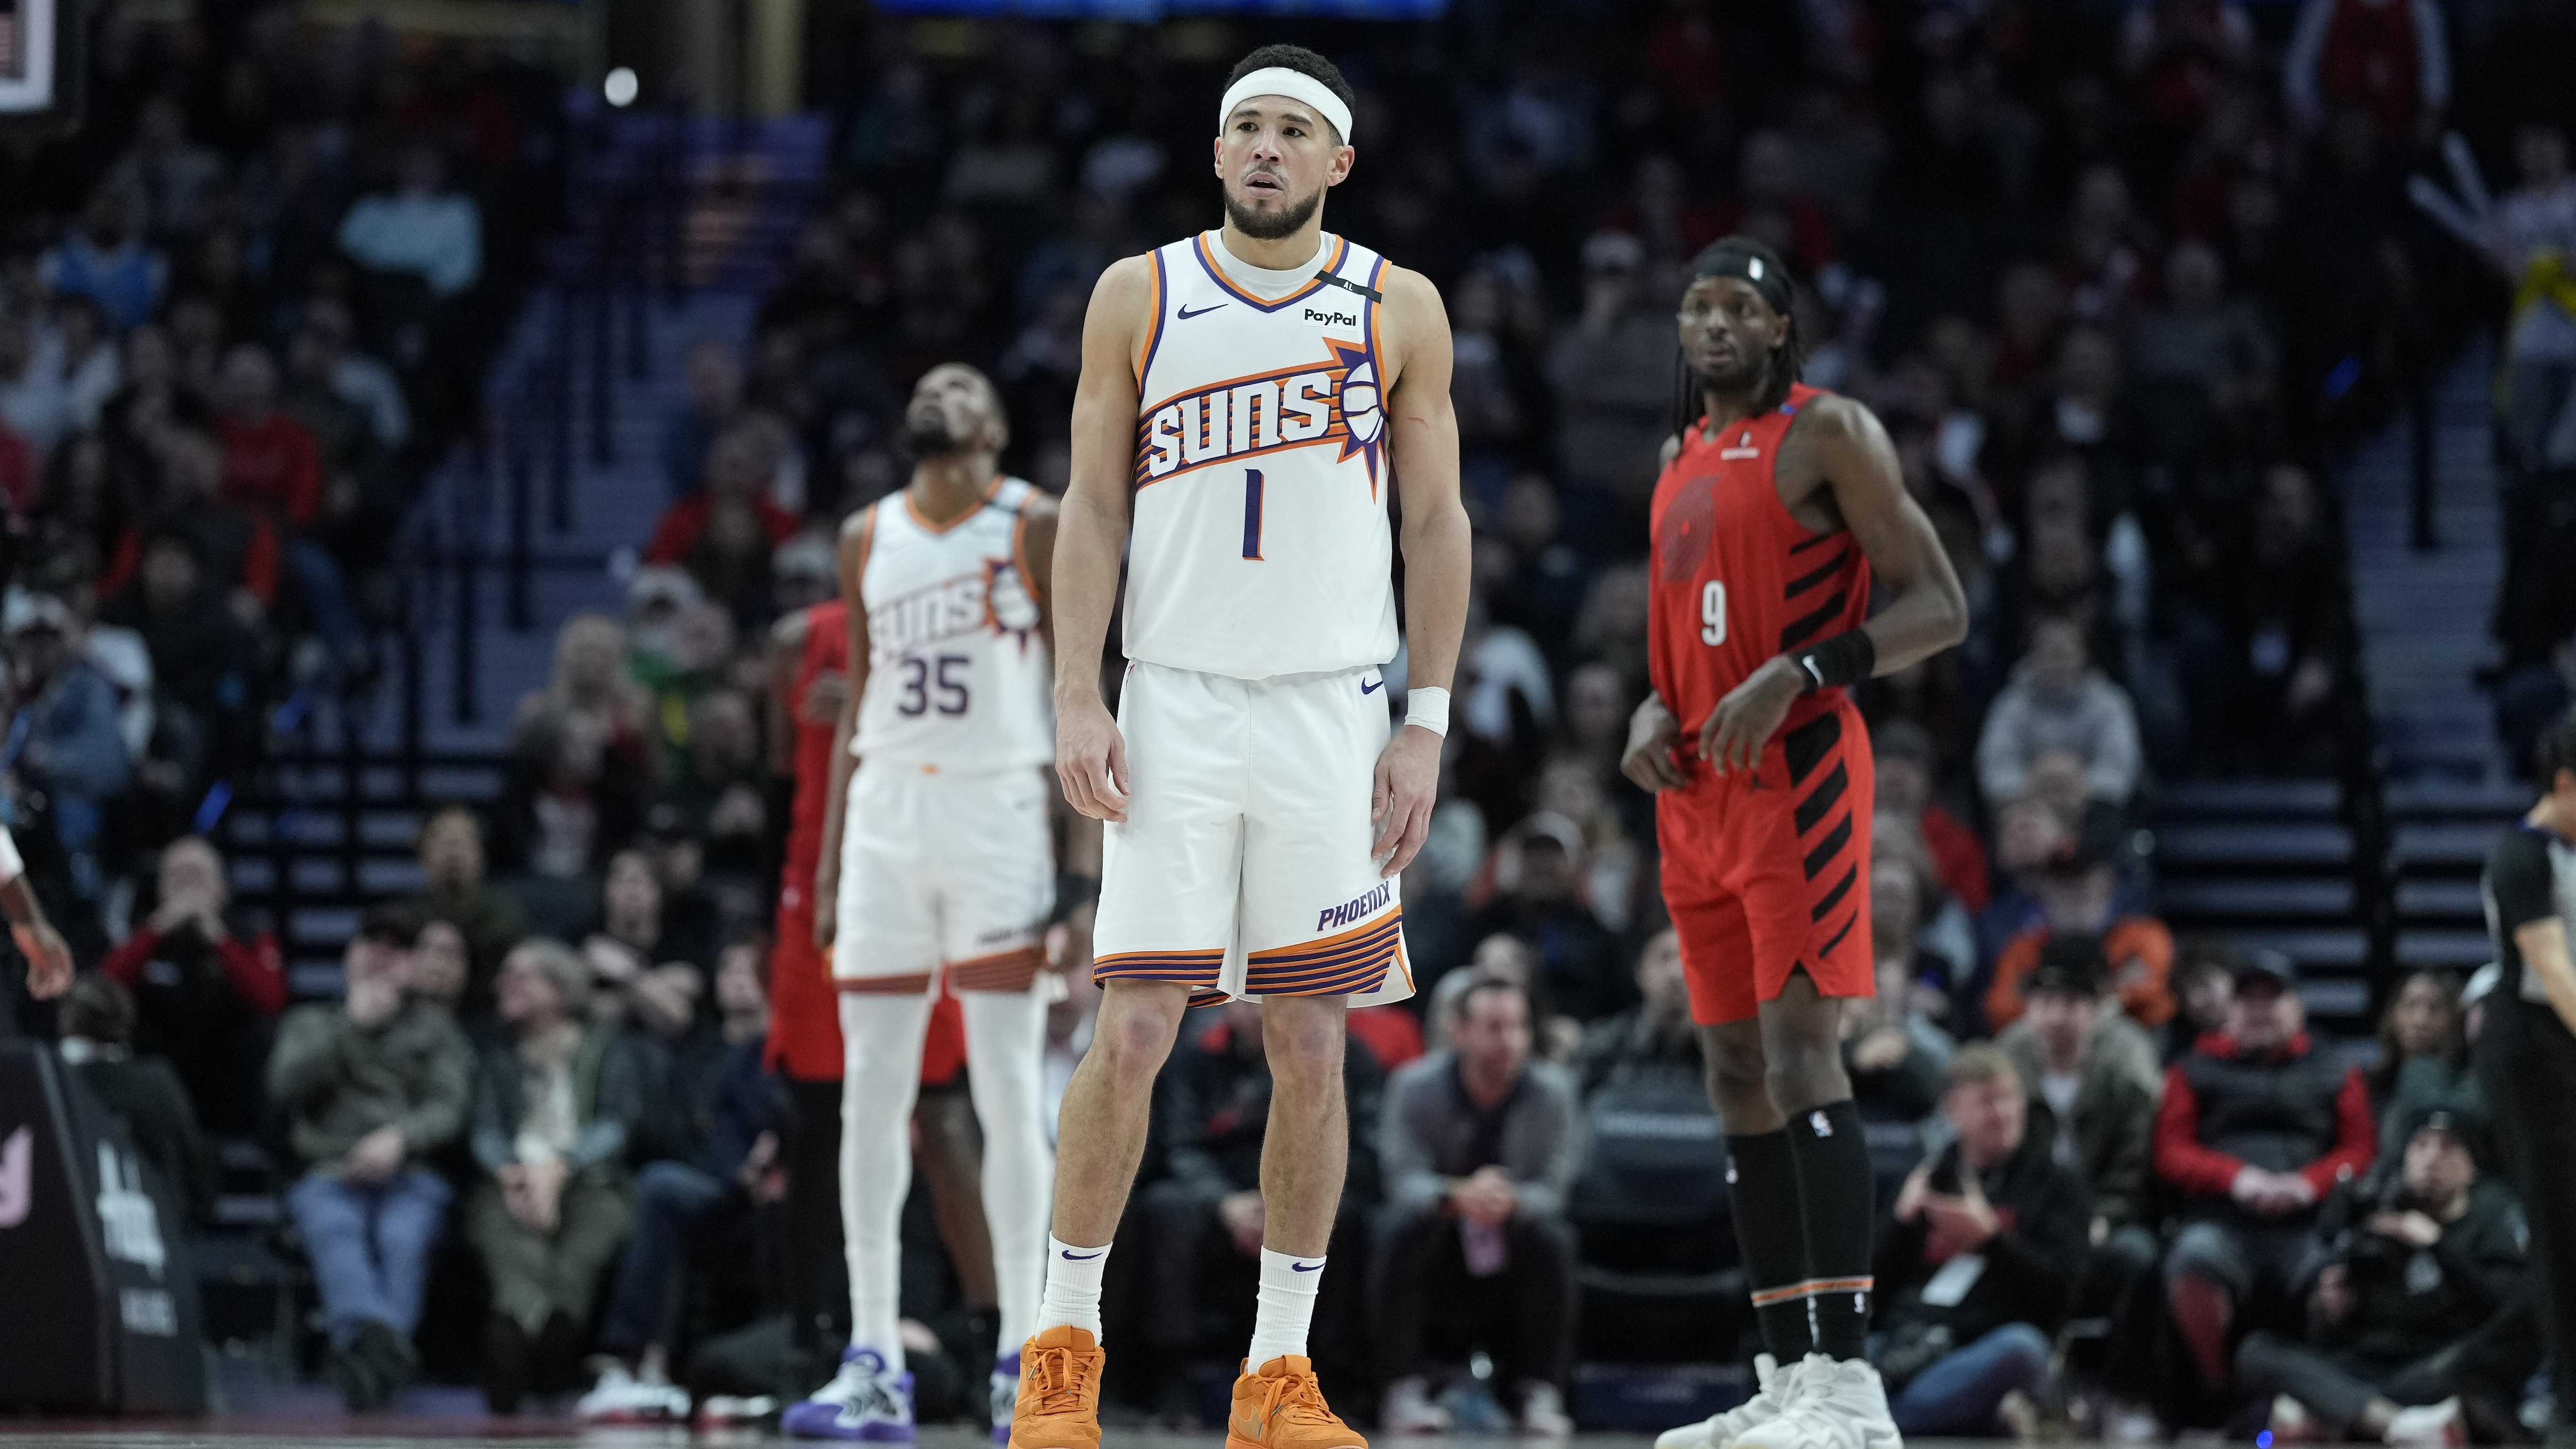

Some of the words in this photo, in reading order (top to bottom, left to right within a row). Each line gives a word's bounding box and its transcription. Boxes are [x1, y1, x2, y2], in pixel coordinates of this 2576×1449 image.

[1343, 281, 1353, 292] AL
[1304, 309, 1356, 326] PayPal
[1149, 371, 1332, 478] SUNS
[1242, 468, 1264, 561] 1
[1701, 579, 1727, 647] 9
[898, 655, 971, 715] 35
[1316, 880, 1391, 932] PHOENIX
